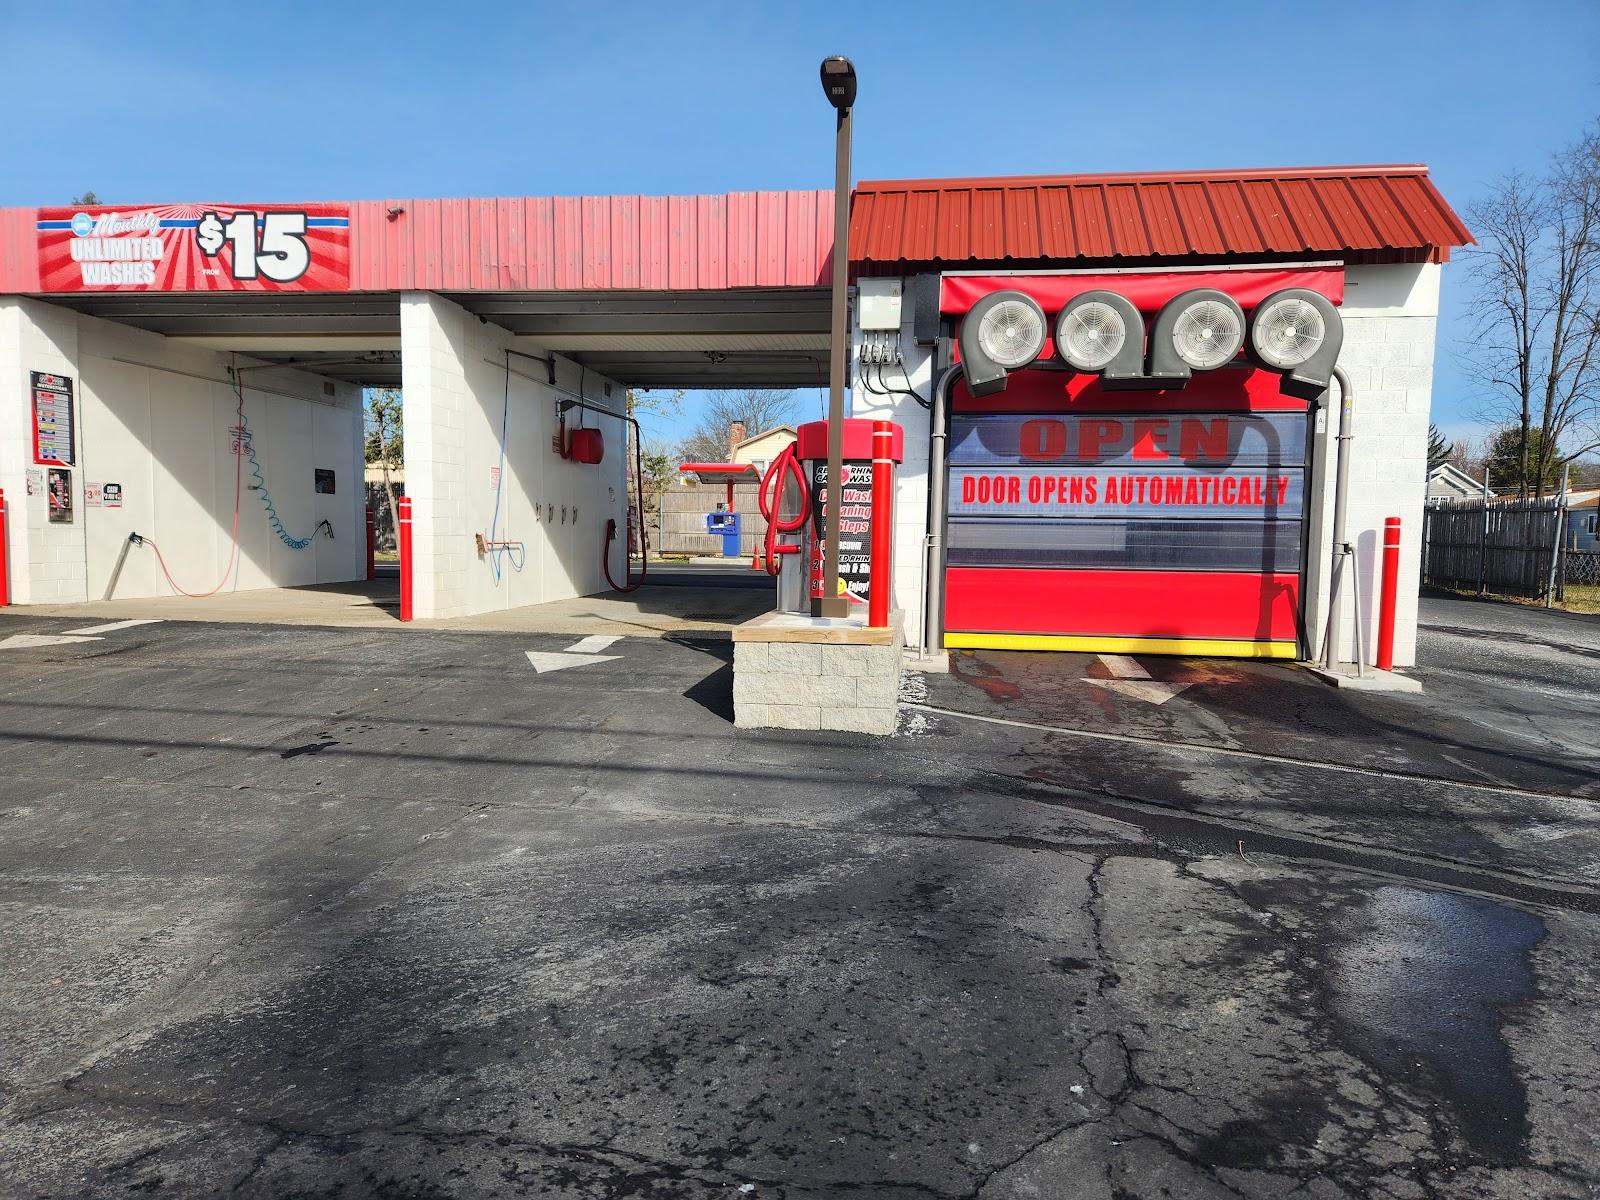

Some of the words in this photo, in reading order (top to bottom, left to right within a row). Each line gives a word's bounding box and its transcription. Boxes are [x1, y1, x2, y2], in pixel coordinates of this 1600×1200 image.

[92, 212, 160, 236] Monthly
[71, 238, 162, 261] UNLIMITED
[197, 211, 311, 283] $15
[82, 261, 154, 285] WASHES
[202, 268, 220, 276] FROM
[1019, 418, 1229, 461] OPEN
[850, 475, 872, 483] WAS
[962, 475, 1021, 504] DOOR
[1028, 475, 1098, 504] OPENS
[1104, 475, 1291, 505] AUTOMATICALLY
[813, 560, 819, 570] 2
[812, 580, 818, 590] 3
